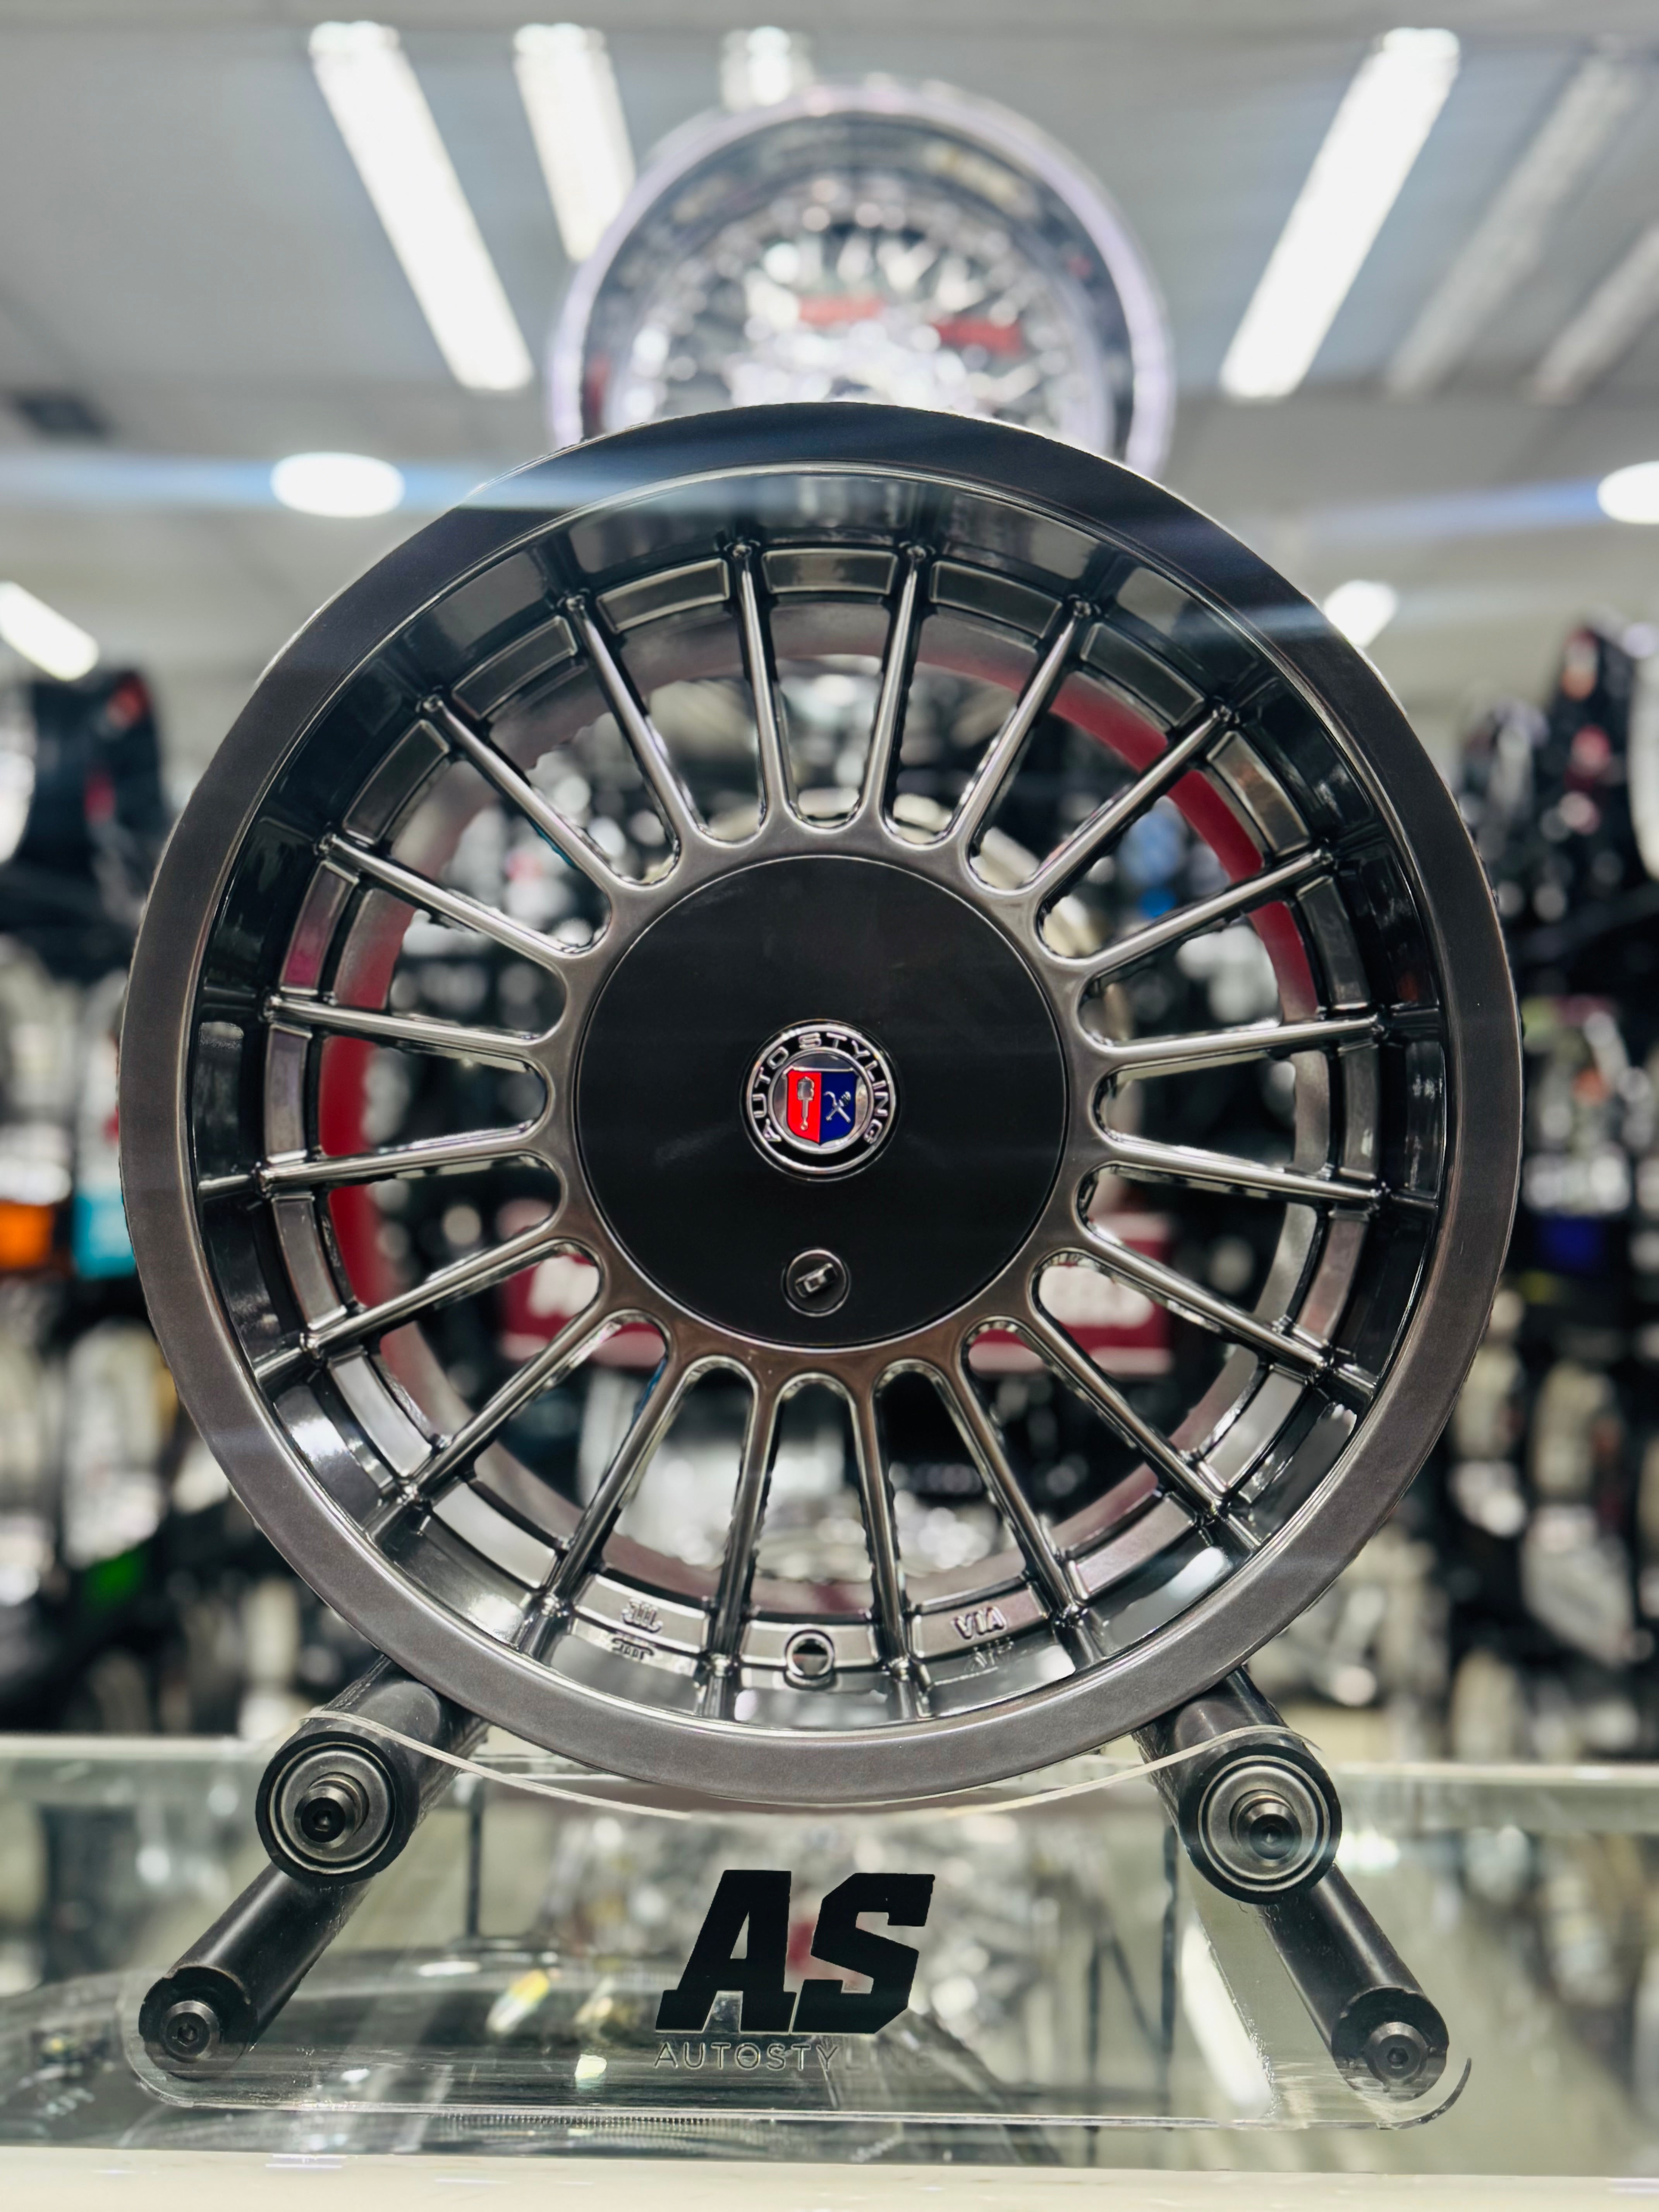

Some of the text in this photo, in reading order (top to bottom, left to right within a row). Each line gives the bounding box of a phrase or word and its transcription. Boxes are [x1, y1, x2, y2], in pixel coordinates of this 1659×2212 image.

[752, 1032, 889, 1144] AUTOSTYLING
[951, 1605, 1006, 1640] VIA
[656, 1870, 935, 2034] AS
[654, 2042, 933, 2072] AUTOSTYL
